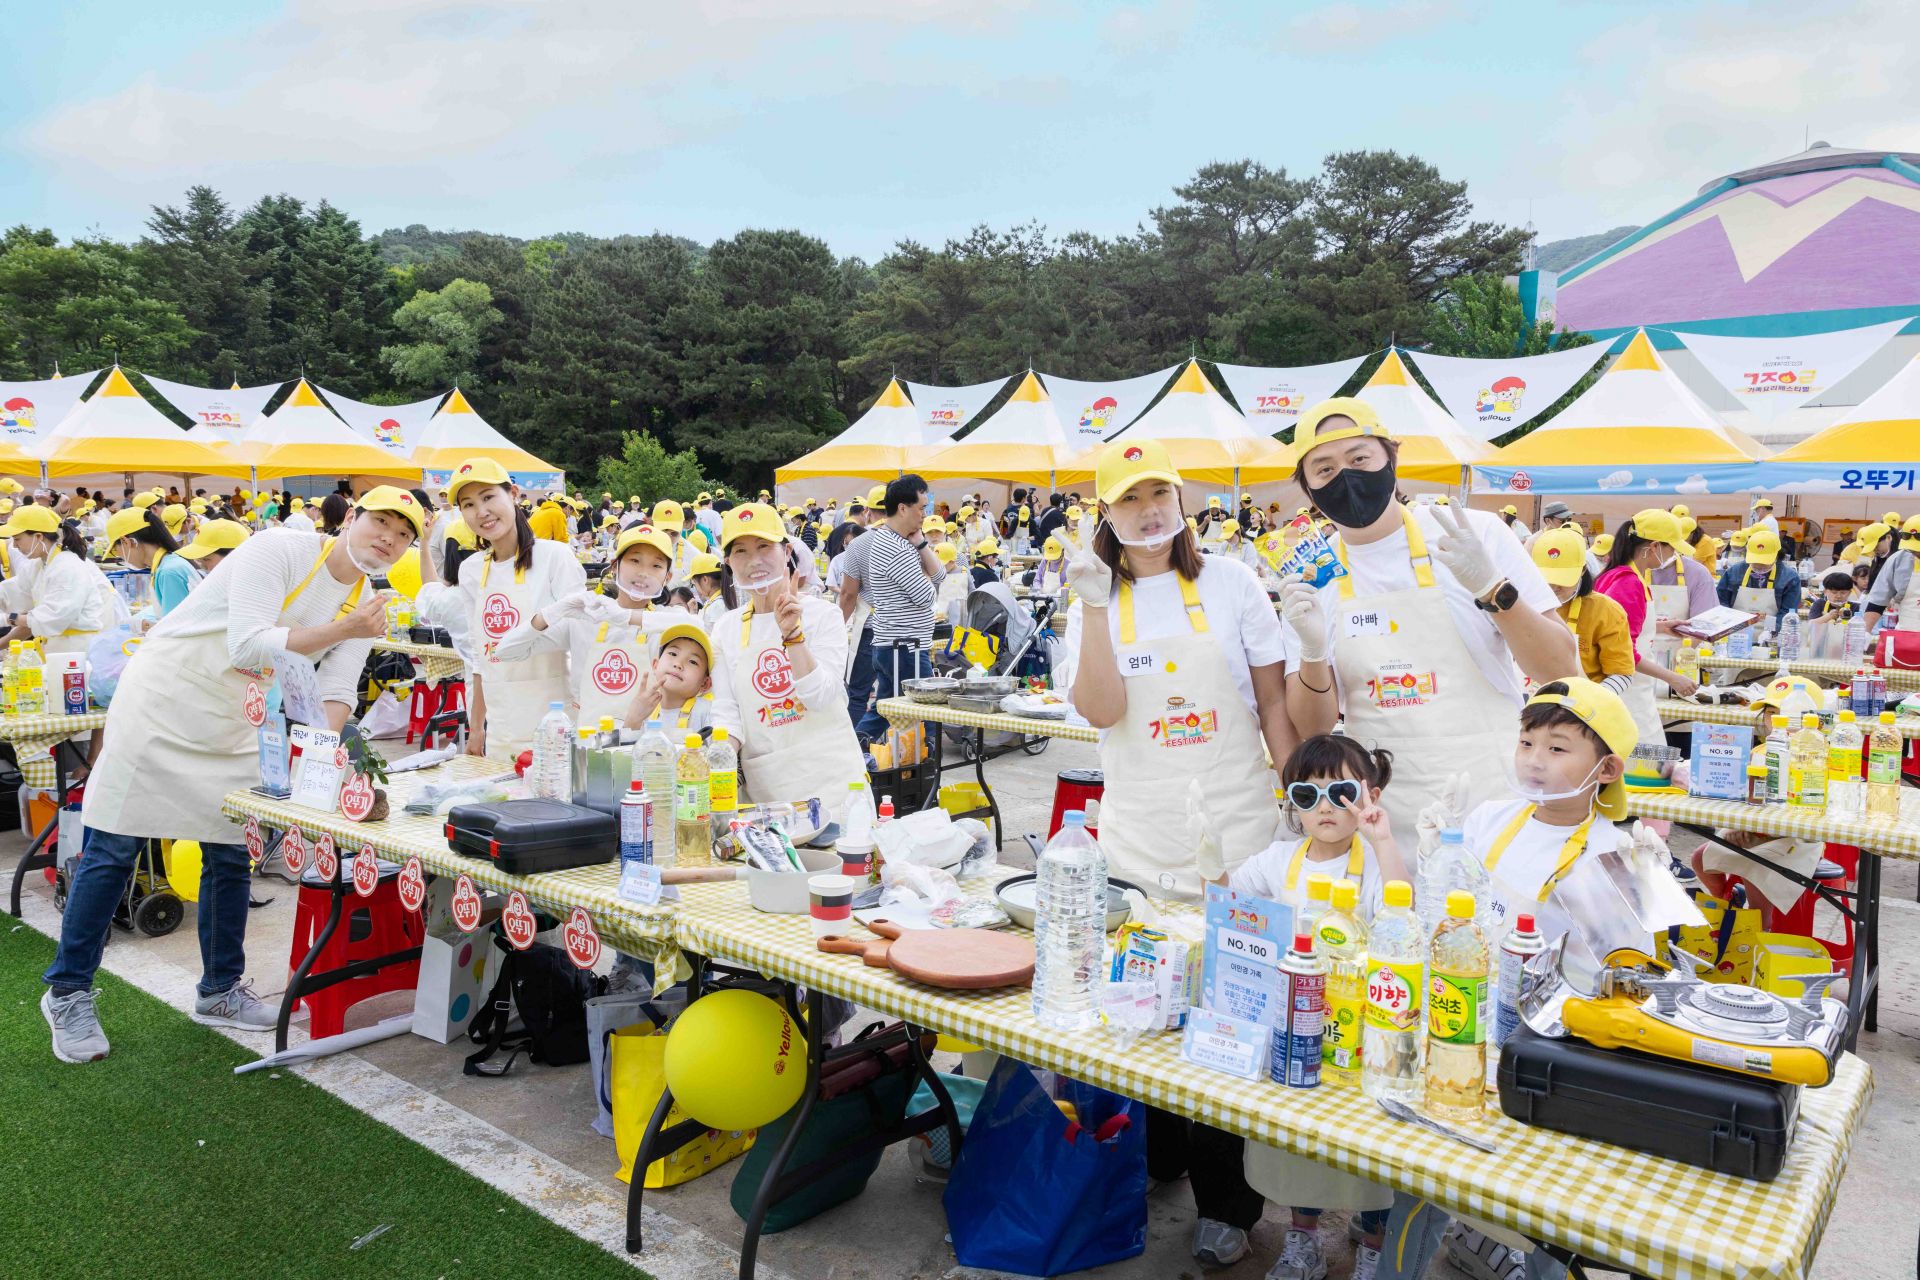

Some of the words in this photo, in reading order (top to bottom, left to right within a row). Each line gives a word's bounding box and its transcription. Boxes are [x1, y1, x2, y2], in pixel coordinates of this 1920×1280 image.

[1840, 470, 1915, 490] 오뚜기
[485, 614, 512, 629] 오뚜기
[1352, 613, 1378, 626] 아빠
[1128, 655, 1153, 669] 엄마
[600, 670, 630, 685] 오뚜기
[761, 669, 793, 690] 오뚜기
[1366, 671, 1438, 700] 가족요리
[1380, 698, 1424, 708] FESTIVAL
[770, 714, 802, 728] FESTIVAL
[1148, 708, 1218, 739] 가족요리
[1165, 735, 1208, 748] FESTIVAL
[345, 793, 369, 811] 오뚜기
[286, 844, 302, 862] 오뚜기
[317, 851, 334, 873] 오뚜기
[357, 866, 375, 885] 오뚜기
[401, 880, 420, 900] 오뚜기
[457, 902, 477, 919] 오뚜기
[508, 917, 531, 936] 오뚜기
[569, 932, 594, 956] 오뚜기
[1227, 937, 1246, 952] NO.
[1249, 944, 1267, 957] 100
[1250, 968, 1262, 979] 가족
[1370, 984, 1407, 1008] 미향
